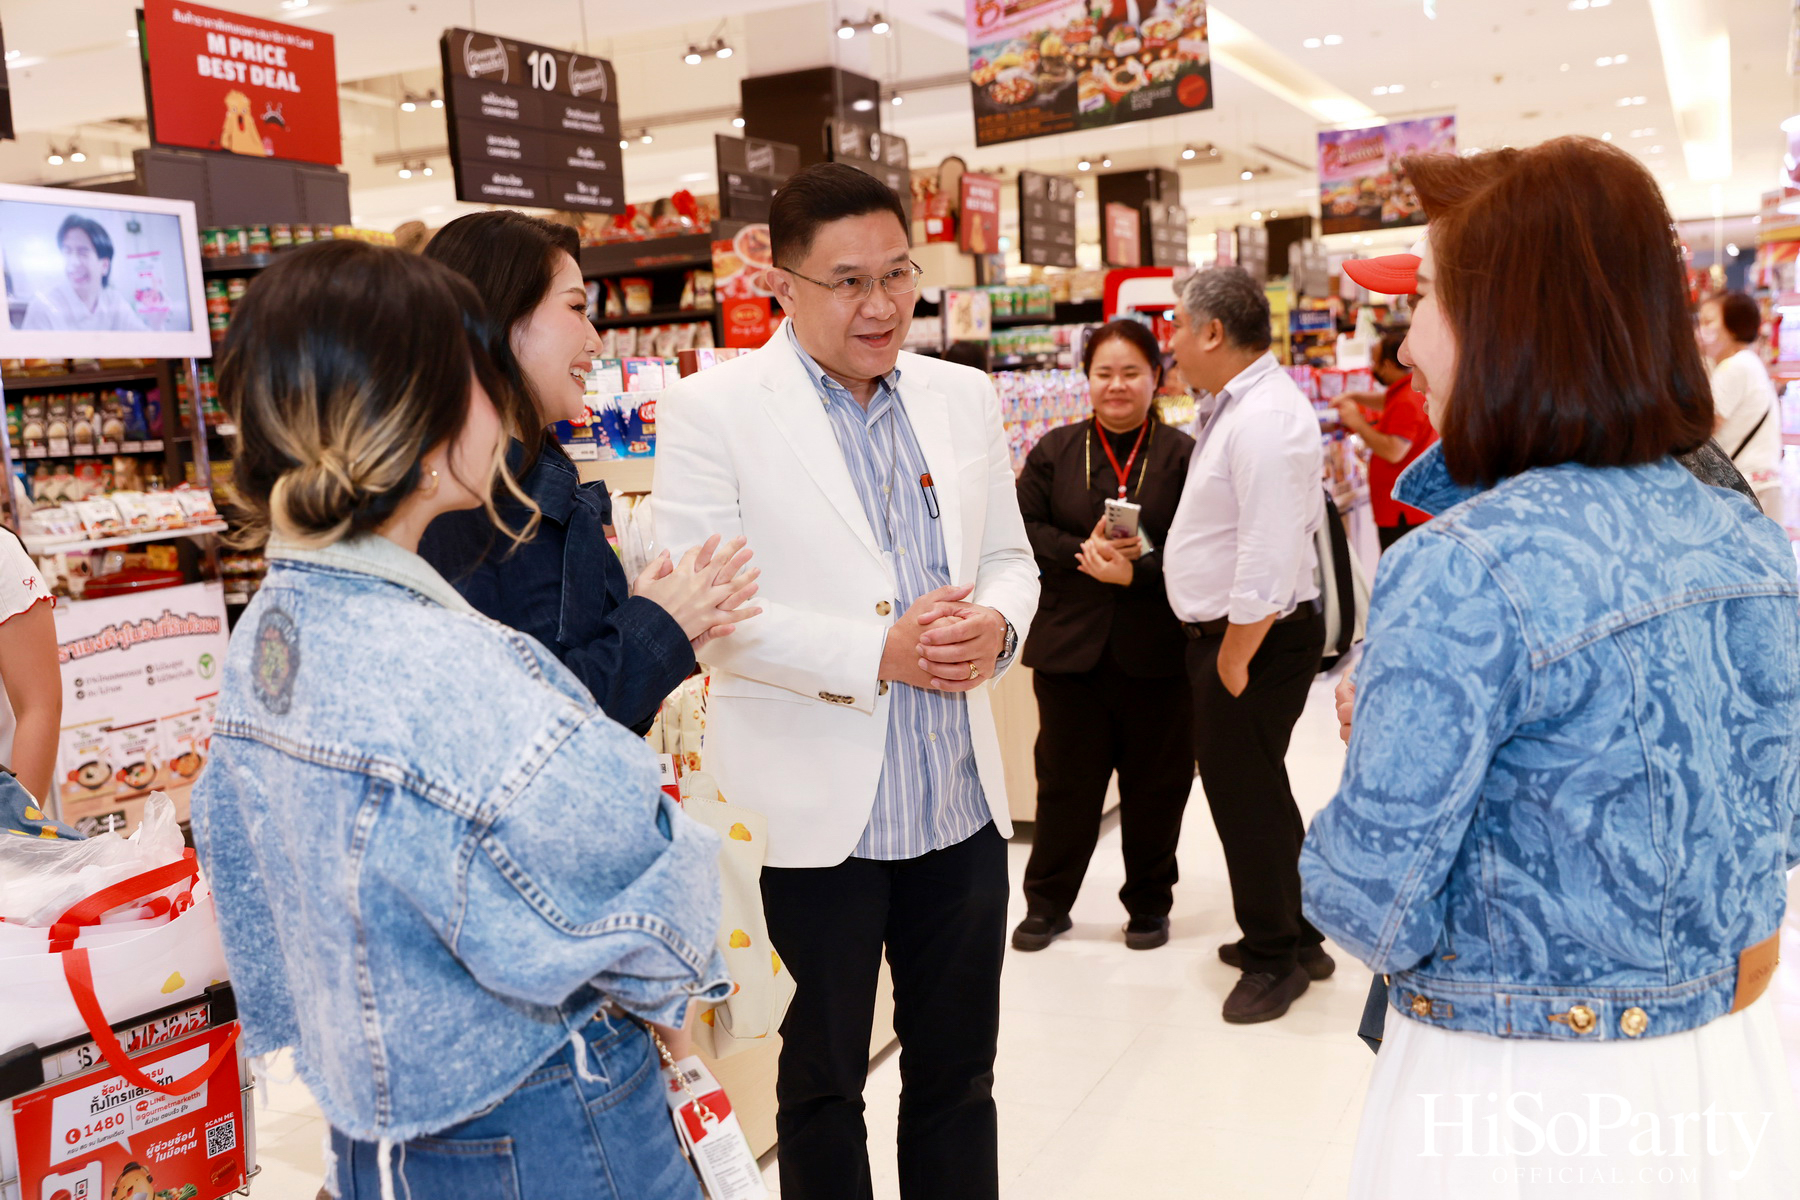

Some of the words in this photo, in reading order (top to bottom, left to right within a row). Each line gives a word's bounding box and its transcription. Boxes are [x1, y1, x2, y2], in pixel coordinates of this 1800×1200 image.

[206, 32, 227, 56] M
[229, 36, 288, 68] PRICE
[197, 54, 248, 84] BEST
[249, 63, 301, 93] DEAL
[526, 49, 557, 92] 10
[135, 1091, 201, 1121] @gourmetmarketth
[149, 1095, 166, 1106] LINE
[83, 1112, 125, 1138] 1480
[204, 1118, 223, 1128] SCAN
[223, 1111, 235, 1121] ME
[155, 1139, 198, 1163] ในมือคุณ
